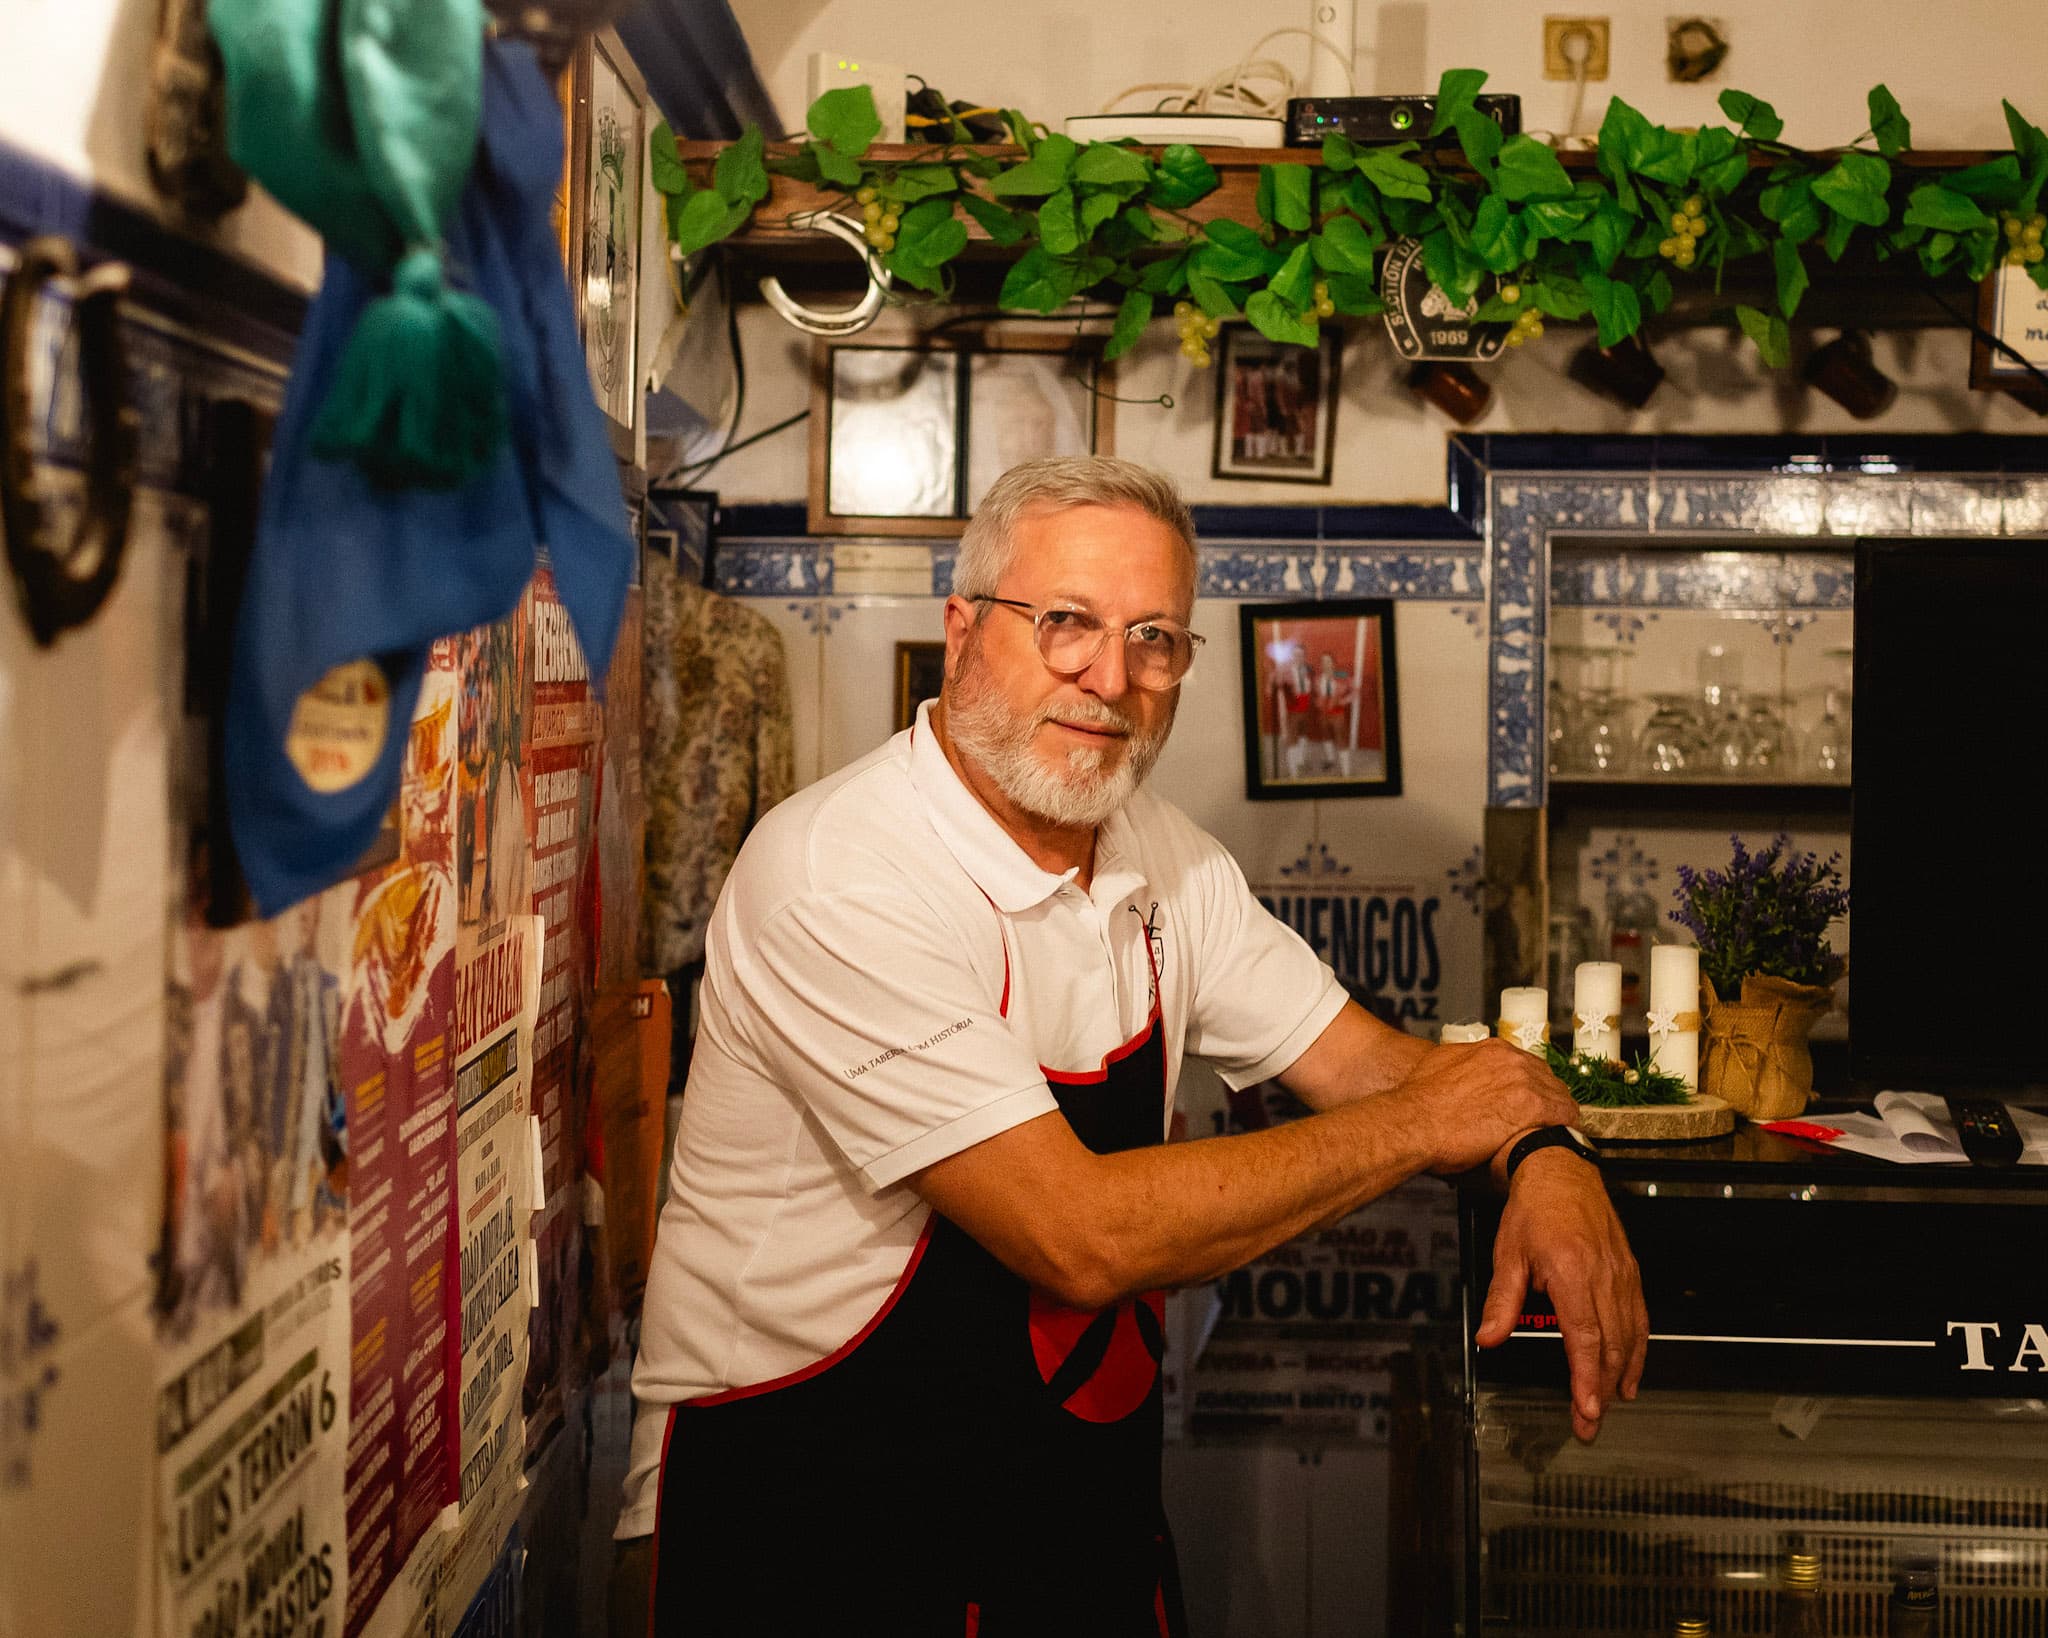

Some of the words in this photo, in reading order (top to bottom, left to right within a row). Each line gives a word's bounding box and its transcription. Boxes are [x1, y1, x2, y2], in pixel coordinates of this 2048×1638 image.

[843, 1064, 868, 1080] UMA
[929, 1017, 974, 1046] HISTÓRIA
[319, 1369, 336, 1432] 6
